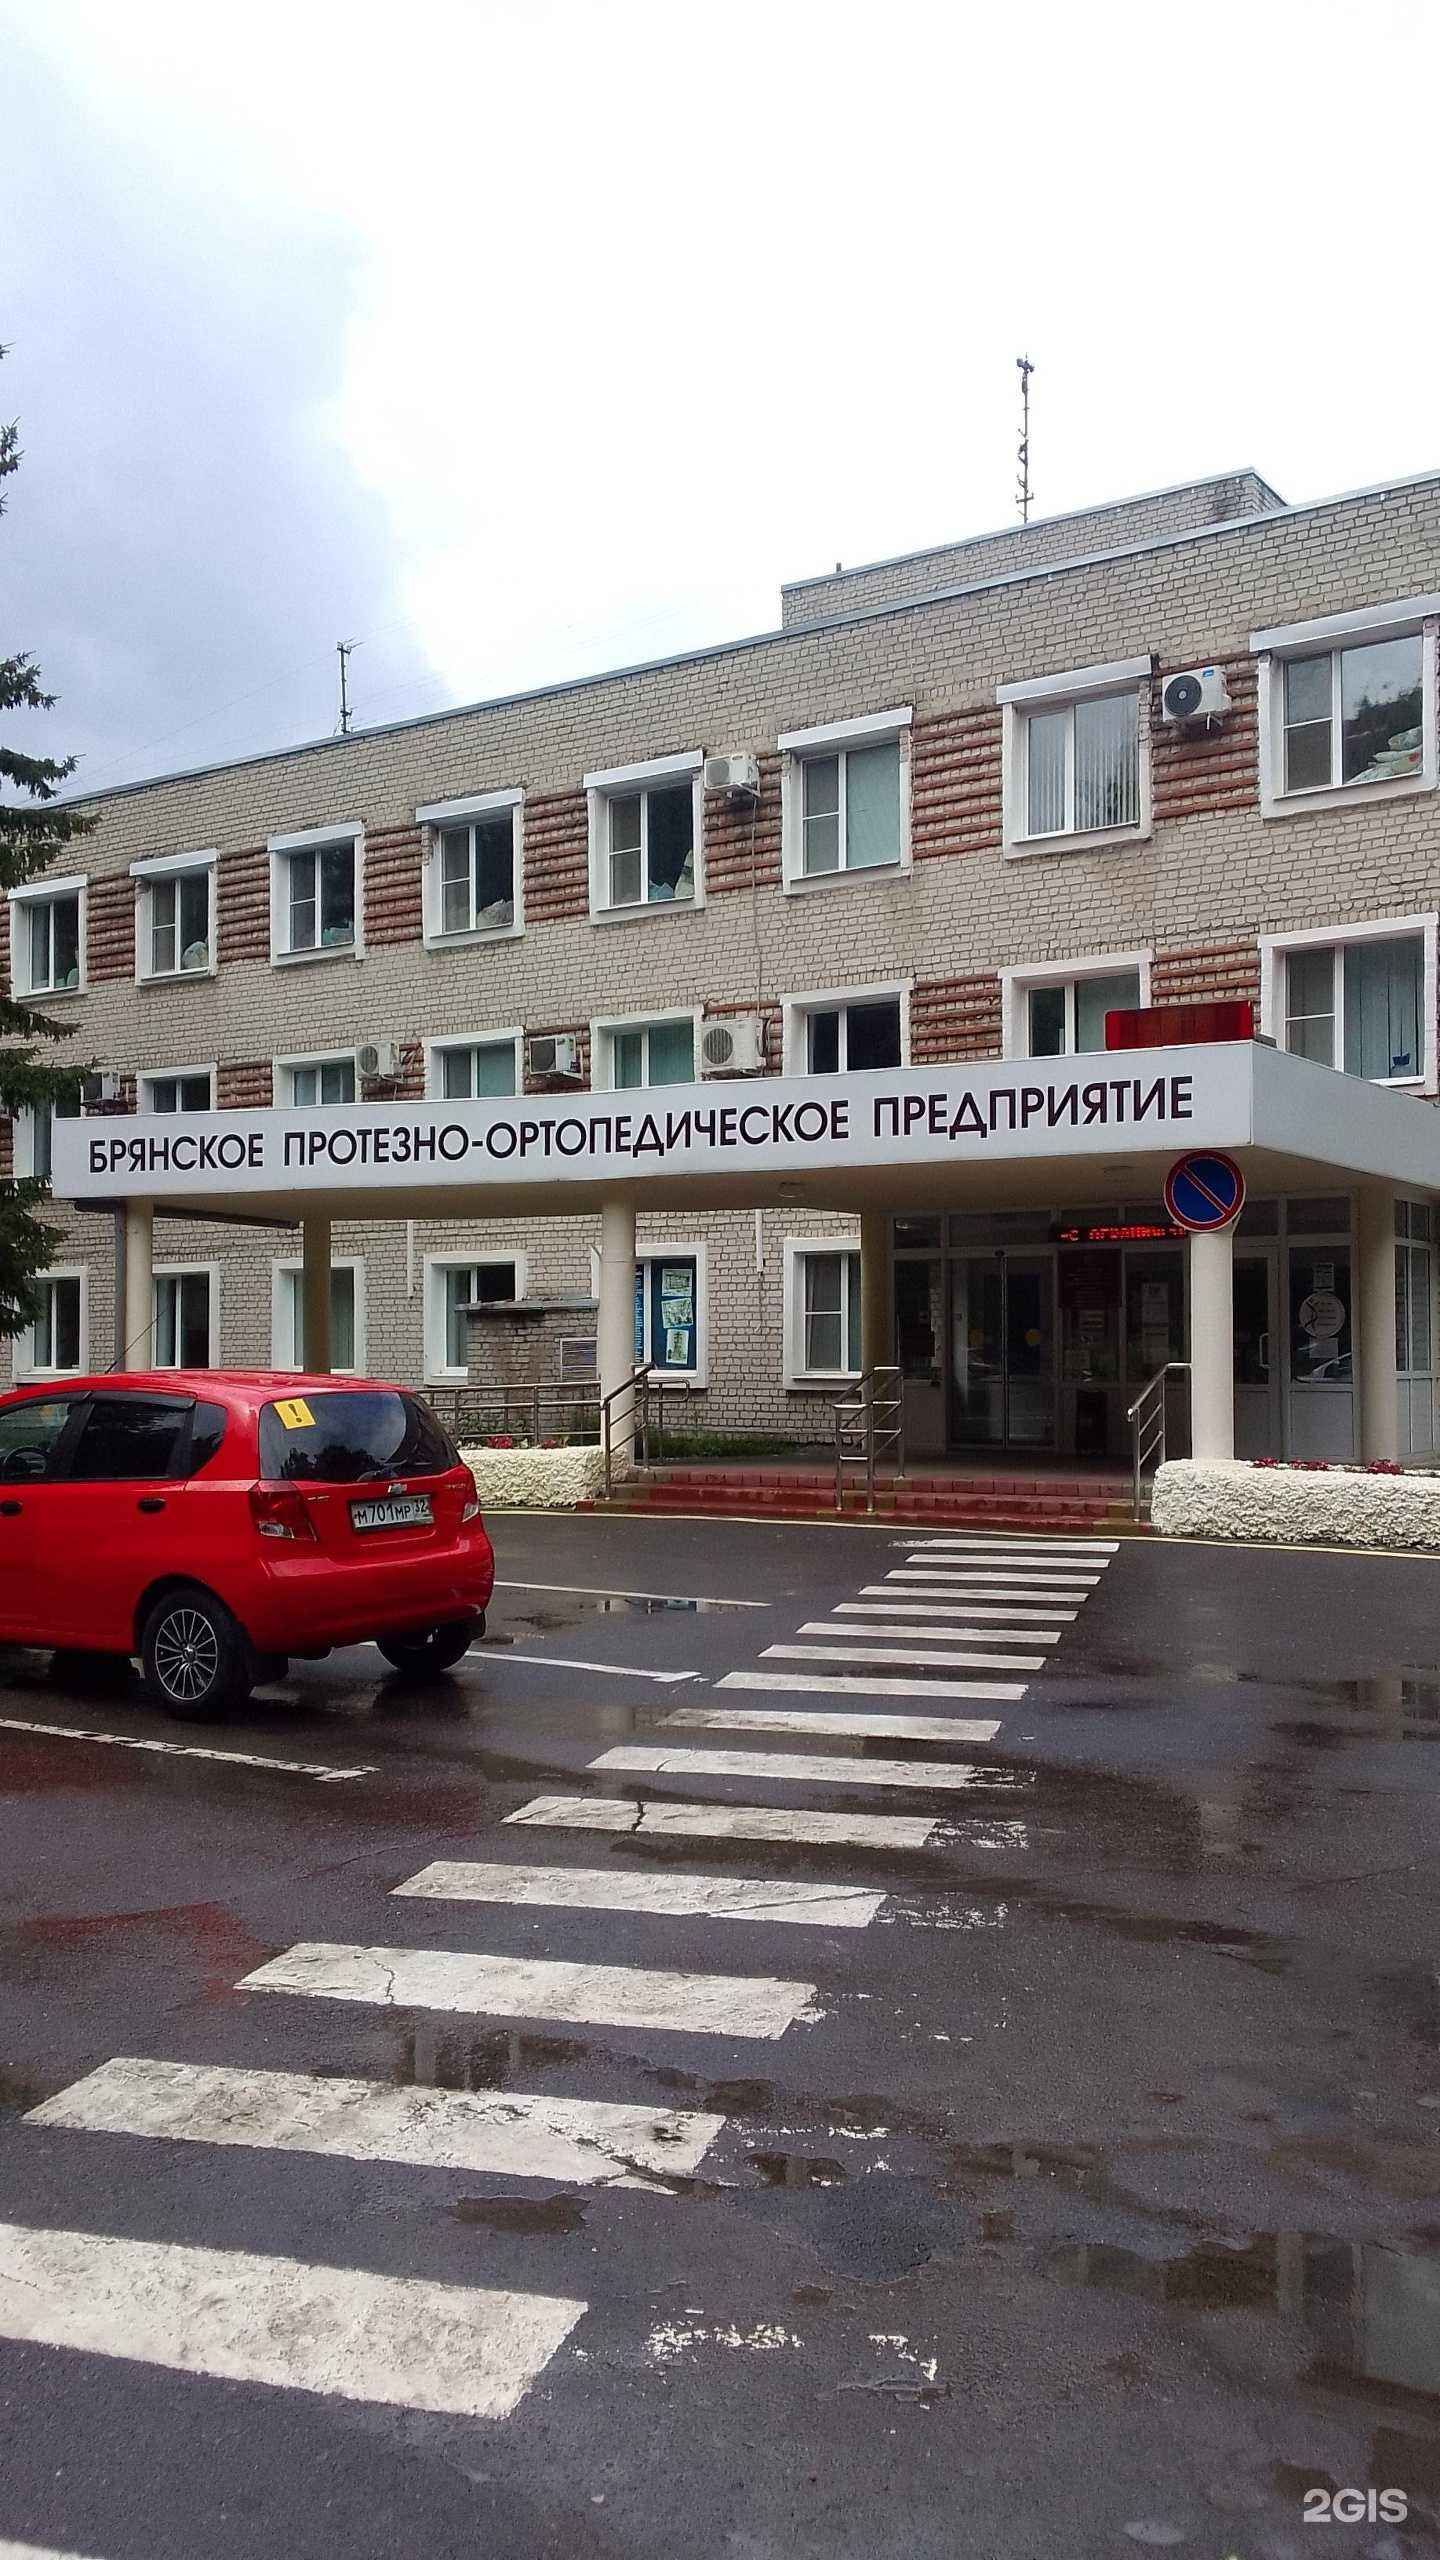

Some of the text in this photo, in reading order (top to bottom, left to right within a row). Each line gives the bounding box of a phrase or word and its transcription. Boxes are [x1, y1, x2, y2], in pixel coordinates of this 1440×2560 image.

[89, 1075, 1193, 1173] БРЯНСКОЕ ПРОТЕЗНО-ОРТОПЕДИЧЕСКОЕ ПРЕДПРИЯТИЕ
